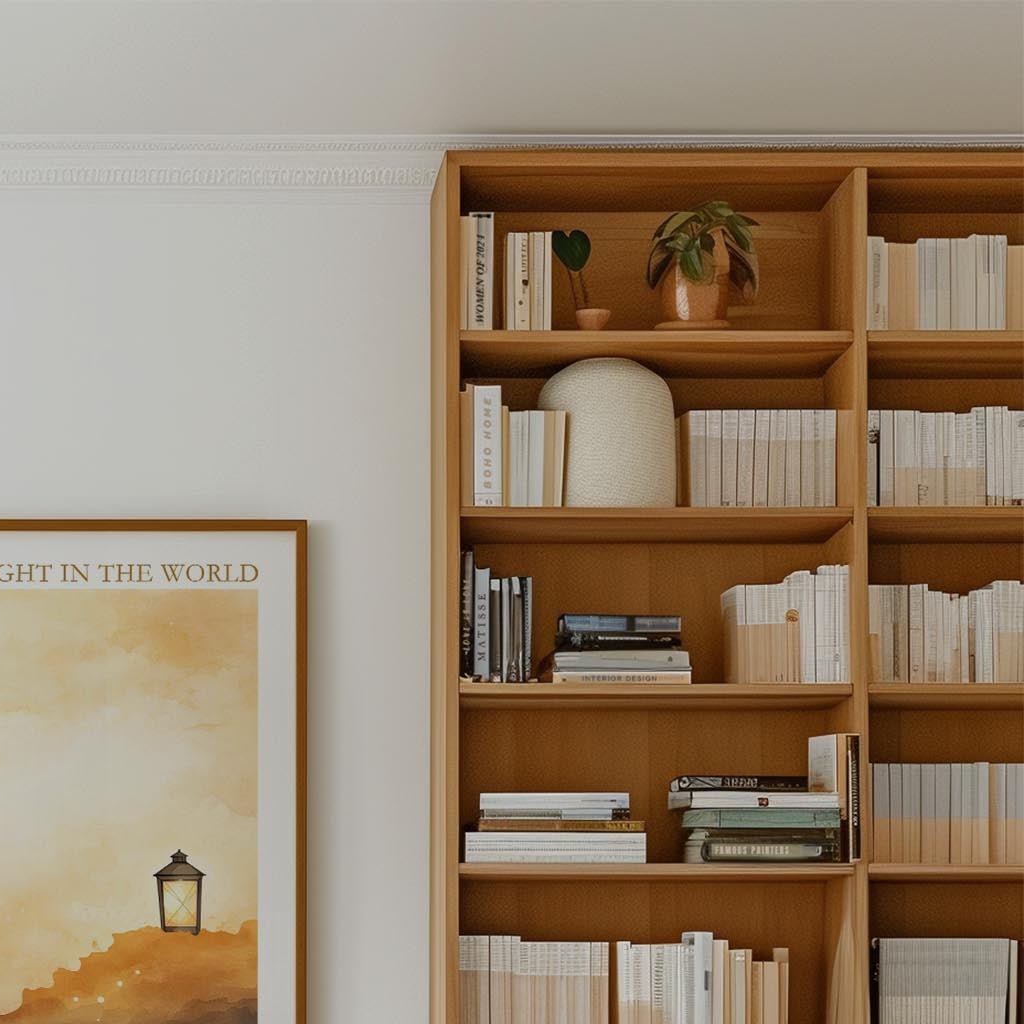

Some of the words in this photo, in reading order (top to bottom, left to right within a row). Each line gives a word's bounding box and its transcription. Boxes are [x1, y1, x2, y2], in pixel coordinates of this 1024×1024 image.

[476, 233, 485, 258] 2024
[476, 258, 485, 276] OF
[475, 278, 485, 323] WOMEN
[483, 397, 492, 440] HOME
[482, 447, 492, 489] BOHO
[60, 564, 89, 583] IN
[98, 564, 153, 583] THE
[160, 564, 259, 583] WORLD
[477, 593, 486, 661] MATISSE
[714, 845, 747, 855] FAMOUS
[751, 845, 789, 855] PAINTERS
